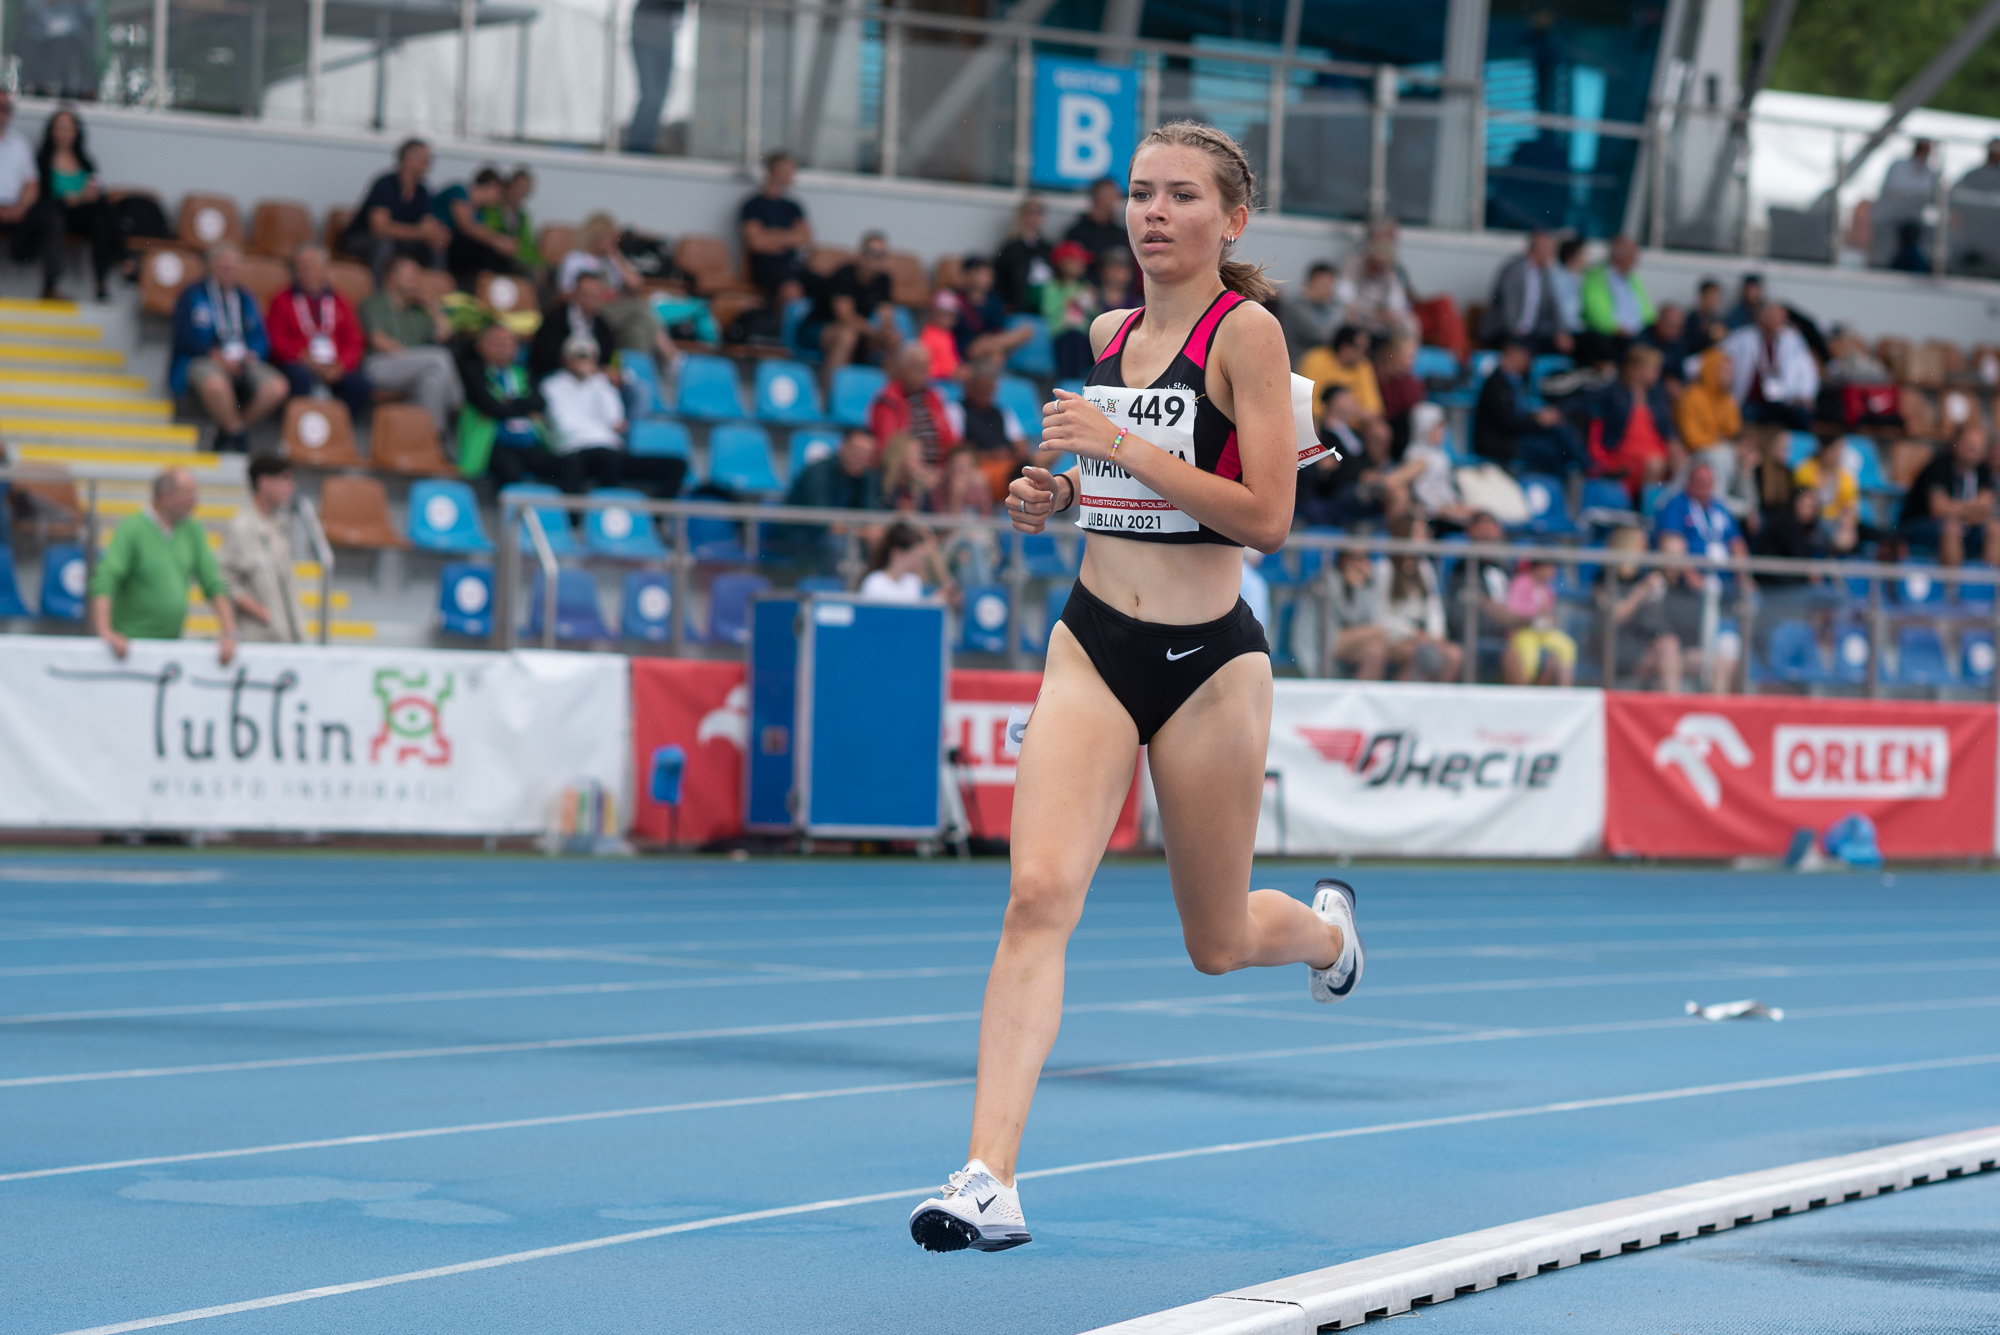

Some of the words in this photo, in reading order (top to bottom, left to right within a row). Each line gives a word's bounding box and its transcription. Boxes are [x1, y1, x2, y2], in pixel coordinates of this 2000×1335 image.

[1056, 93, 1113, 180] B
[1128, 395, 1185, 426] 449
[1141, 501, 1171, 509] POLSKI
[1088, 512, 1124, 528] LUBLIN
[1127, 515, 1161, 530] 2021
[1786, 740, 1935, 785] ORLEN
